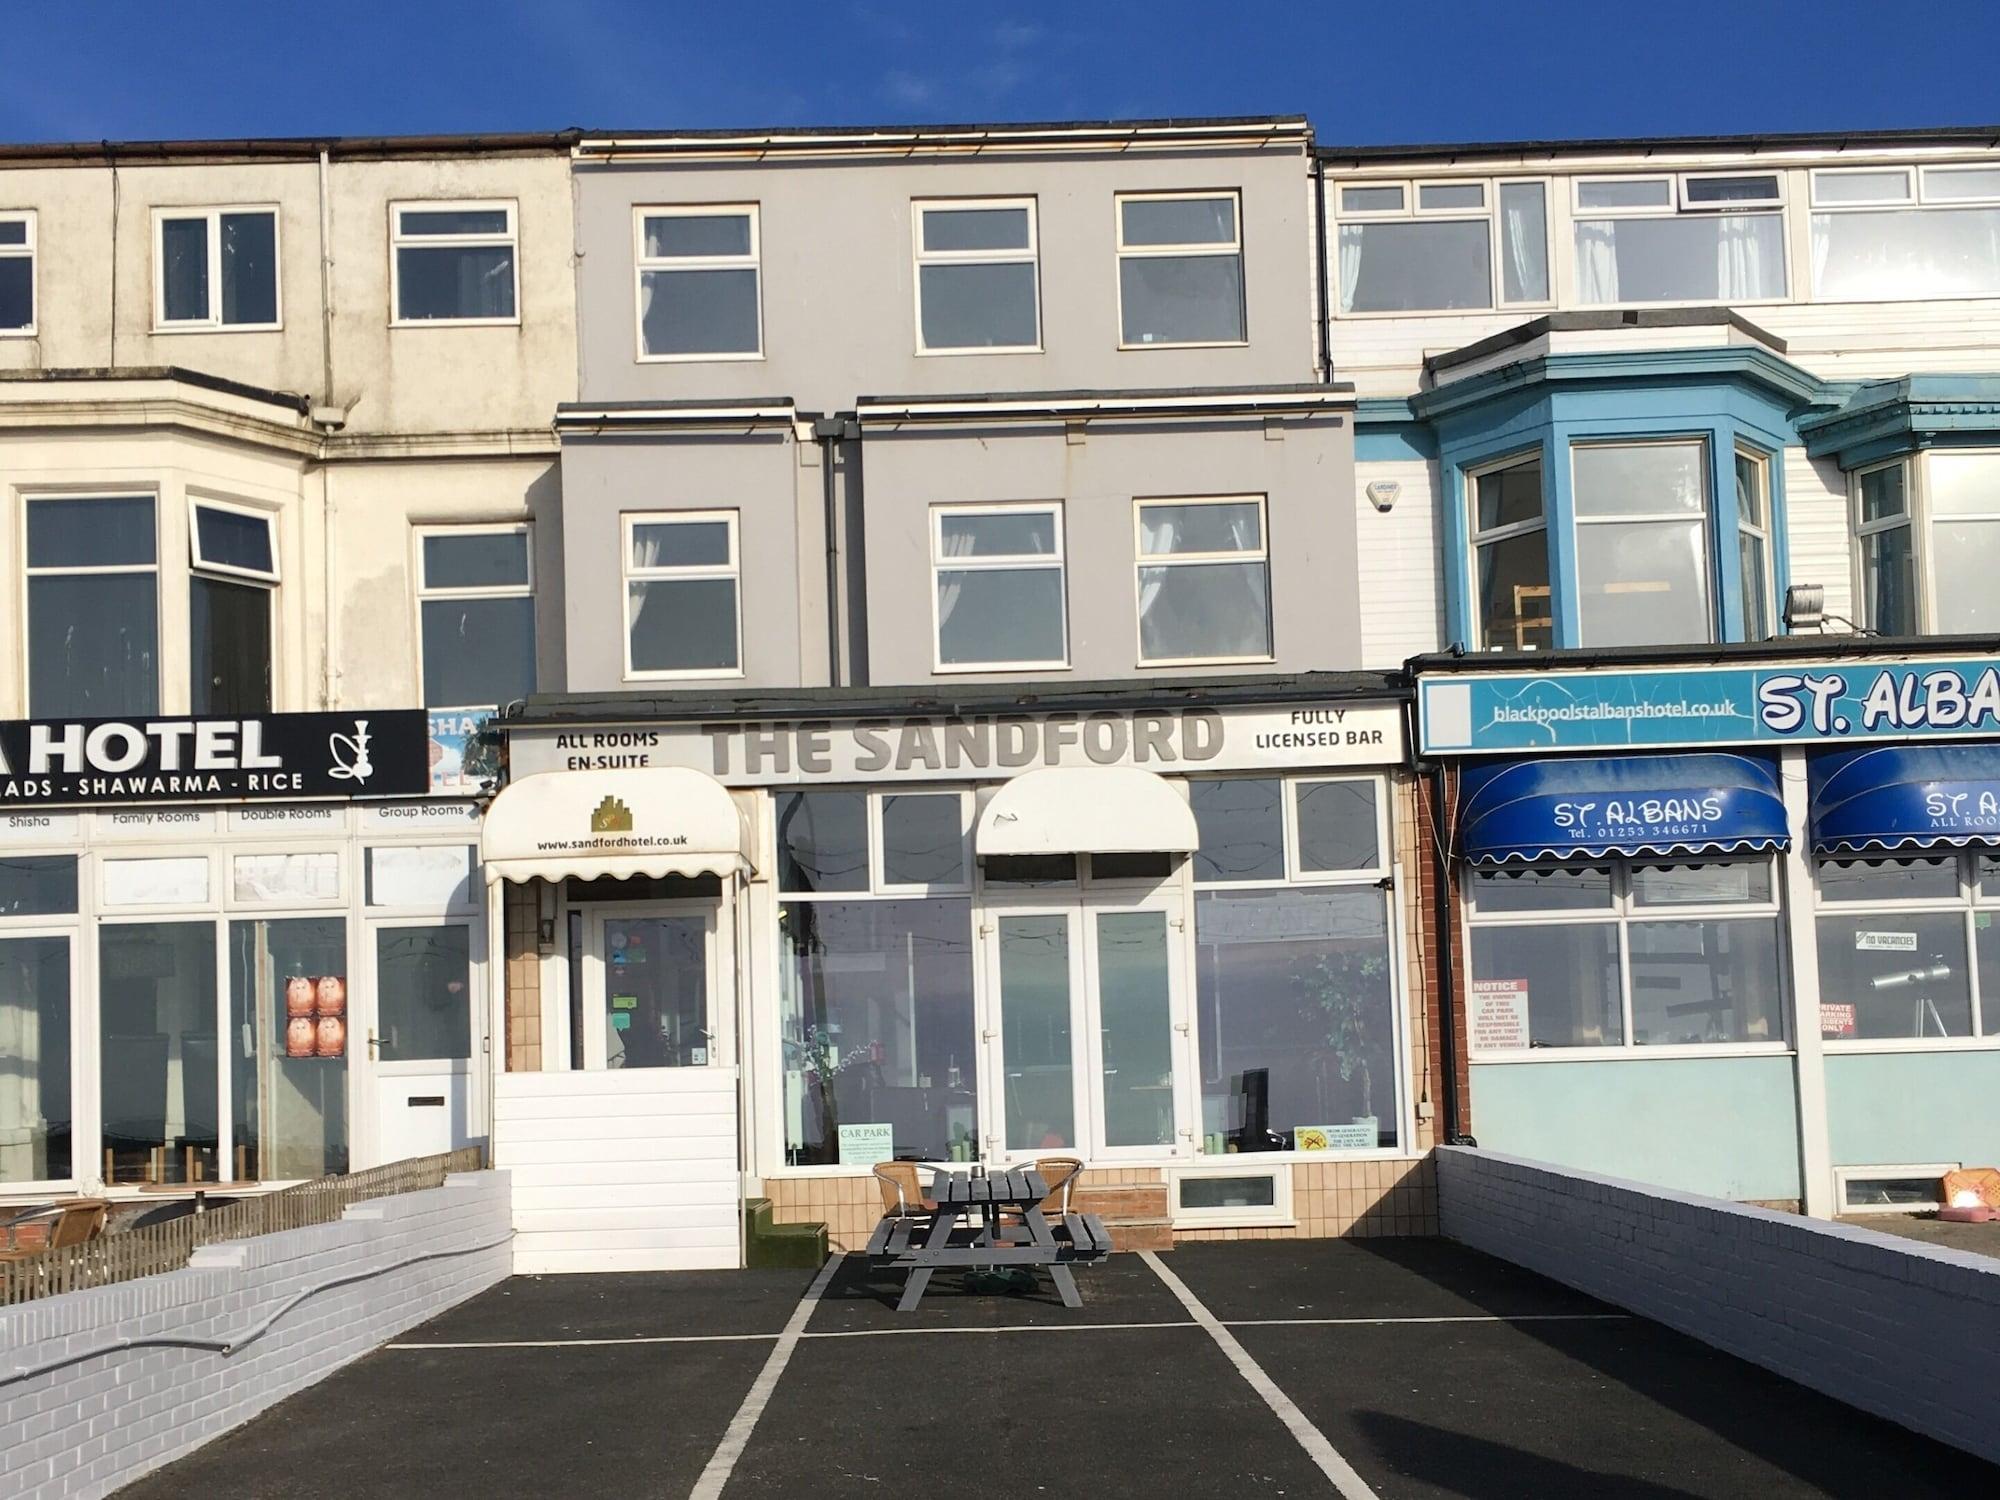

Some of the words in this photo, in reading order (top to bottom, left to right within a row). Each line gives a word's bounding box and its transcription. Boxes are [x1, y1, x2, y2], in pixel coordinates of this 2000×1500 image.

[1494, 699, 1735, 724] blackpoolstalbanshotel.co.uk
[1758, 673, 1851, 735] ST.
[1291, 709, 1346, 725] FULLY
[29, 720, 283, 774] HOTEL
[557, 734, 588, 749] ALL
[594, 732, 659, 748] ROOMS
[701, 720, 832, 776] THE
[853, 707, 1225, 772] SANDFORD
[1256, 732, 1340, 749] LICENSED
[1346, 730, 1383, 745] BAR
[567, 755, 649, 771] EN-SUITE
[0, 780, 52, 797] ADS
[79, 776, 221, 795] SHAWARMA
[248, 773, 303, 790] RICE
[112, 813, 153, 825] Family
[157, 812, 200, 823] Rooms
[241, 809, 286, 821] Double
[289, 808, 332, 819] Rooms
[379, 806, 418, 819] Group
[421, 805, 464, 816] Rooms
[1606, 798, 1722, 825] ALBANS
[9, 816, 50, 828] Shisha
[1930, 818, 1957, 828] ALL
[1964, 816, 2000, 826] ROO
[1568, 829, 1591, 839] Tel.
[1598, 826, 1645, 838] 01253
[1652, 824, 1708, 836] 346671
[537, 835, 687, 850] www.sandfordhotel.co.uk
[1473, 982, 1518, 991] NOTICE
[841, 1129, 861, 1138] CAR
[864, 1128, 890, 1137] PARK
